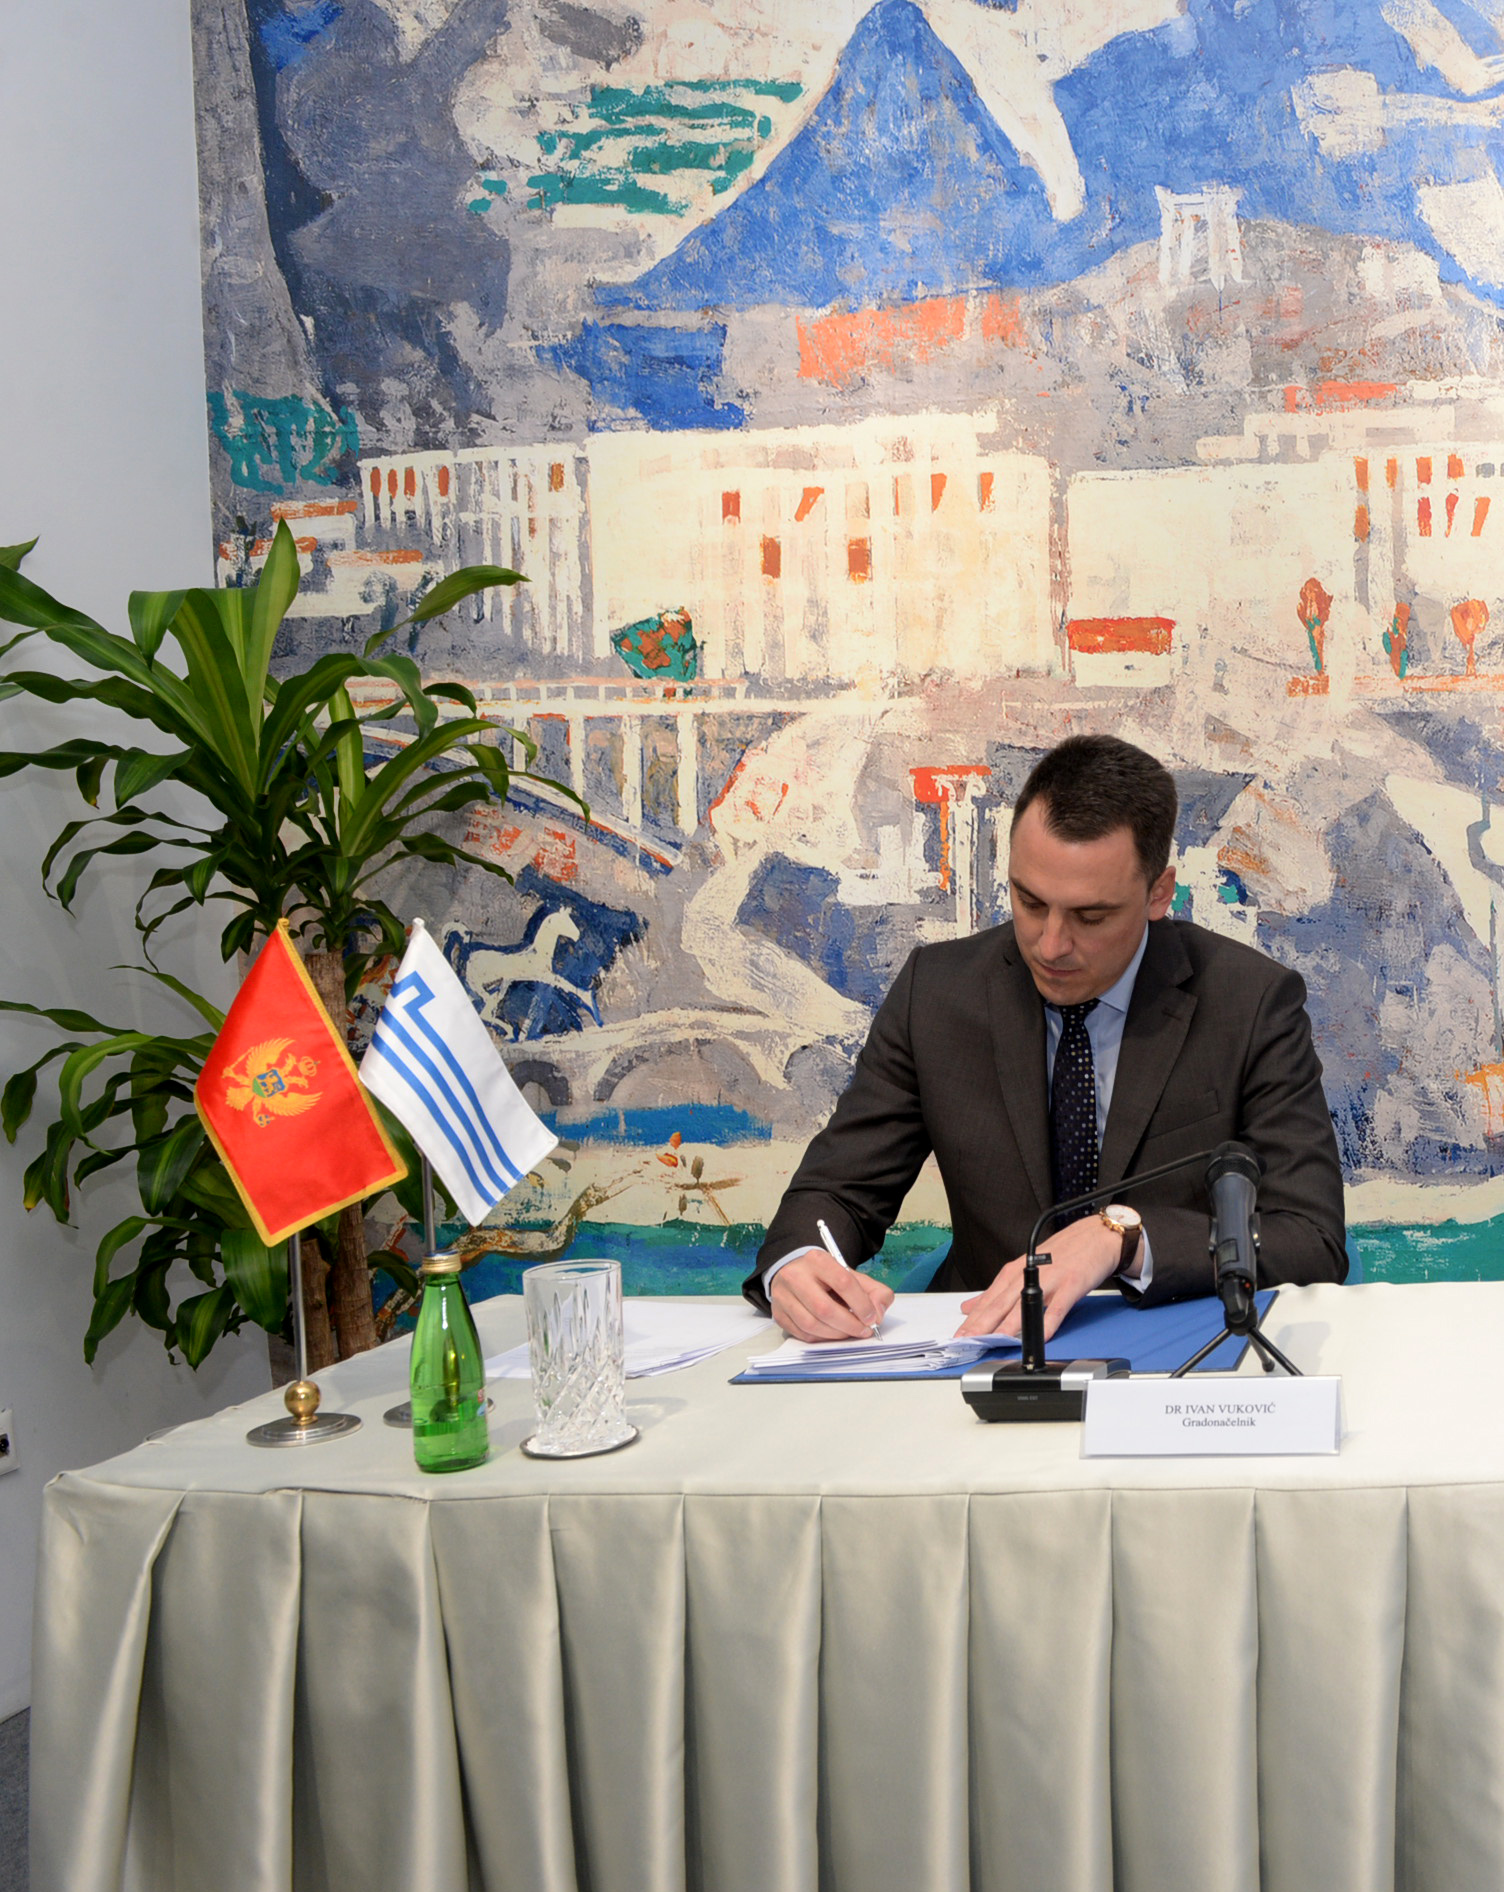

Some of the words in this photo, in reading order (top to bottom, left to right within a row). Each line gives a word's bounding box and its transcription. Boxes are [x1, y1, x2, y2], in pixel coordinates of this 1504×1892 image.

[1165, 1404, 1182, 1414] DR
[1185, 1404, 1215, 1414] IVAN
[1218, 1402, 1276, 1414] VUKOVIĆ
[1182, 1417, 1257, 1427] Gradonačelnik
